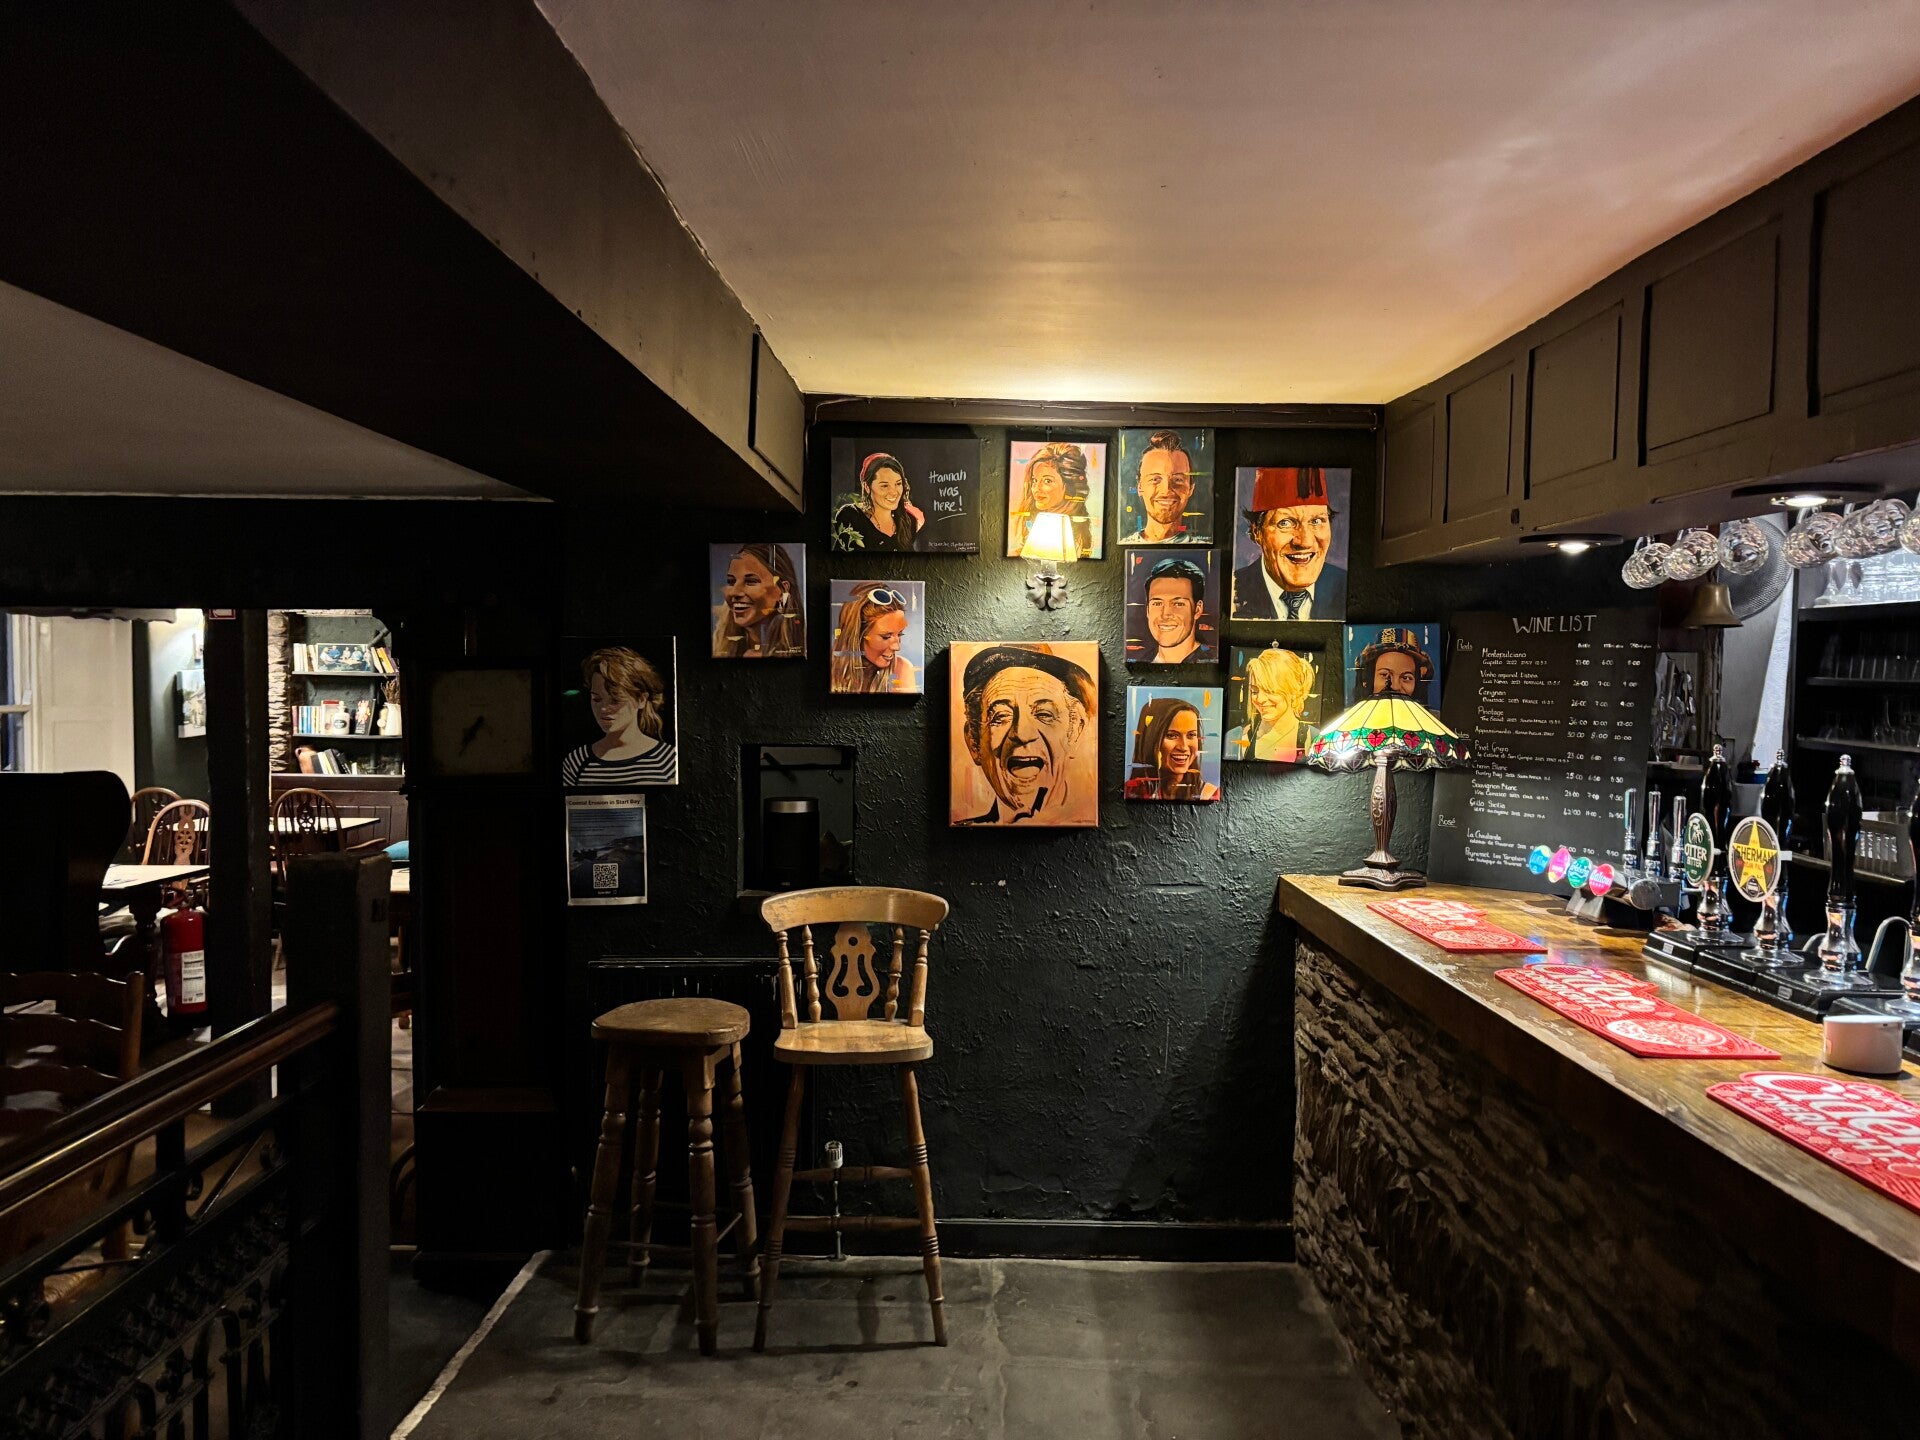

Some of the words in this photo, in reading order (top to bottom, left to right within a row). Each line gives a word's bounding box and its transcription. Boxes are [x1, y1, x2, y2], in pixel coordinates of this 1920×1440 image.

[929, 469, 966, 483] Hannah
[939, 487, 959, 497] was
[1512, 616, 1555, 633] WINE
[1559, 614, 1597, 632] LIST
[1481, 648, 1527, 660] Montepulciano
[1477, 705, 1504, 717] Pinotage
[1474, 740, 1489, 751] Pinot
[1471, 779, 1500, 789] Sauvignon
[1466, 827, 1475, 838] La
[1684, 843, 1707, 861] OTTER
[1736, 845, 1774, 863] SHERMAN
[1531, 964, 1657, 1006] Cider
